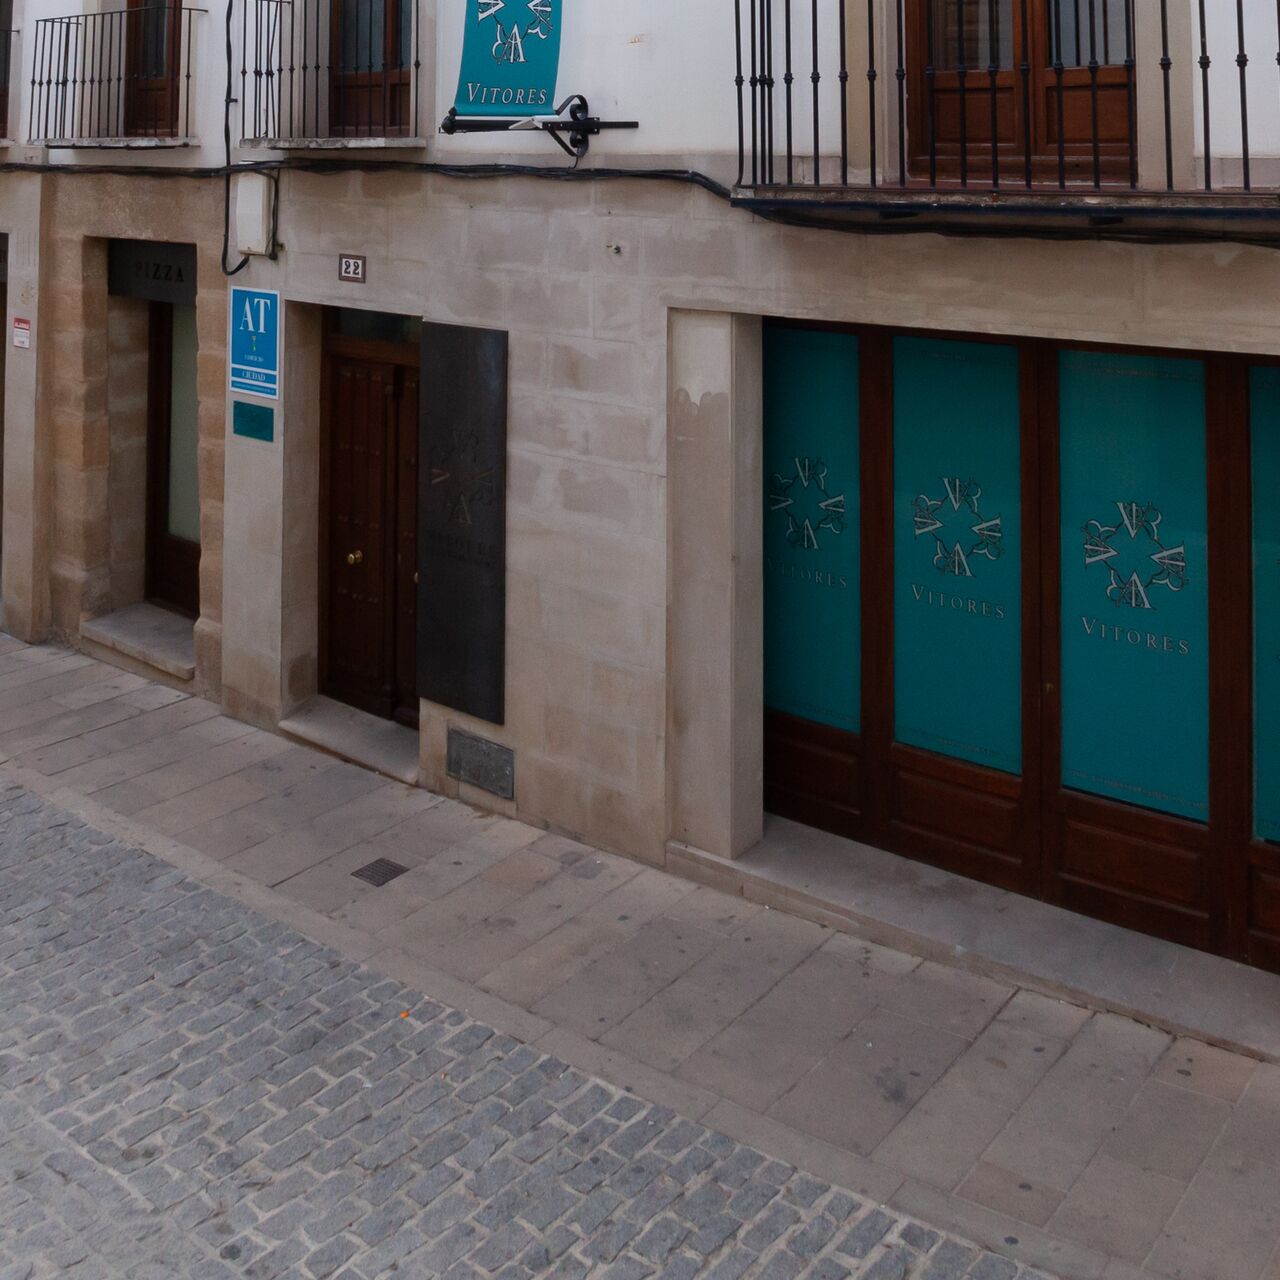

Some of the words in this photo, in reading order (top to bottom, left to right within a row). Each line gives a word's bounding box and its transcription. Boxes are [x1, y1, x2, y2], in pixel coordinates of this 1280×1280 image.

[467, 82, 547, 105] VITORES
[135, 261, 184, 282] PIZZA
[343, 260, 360, 276] 22
[239, 296, 271, 333] AT
[911, 583, 1005, 619] VITORES
[1081, 616, 1189, 655] VITORES
